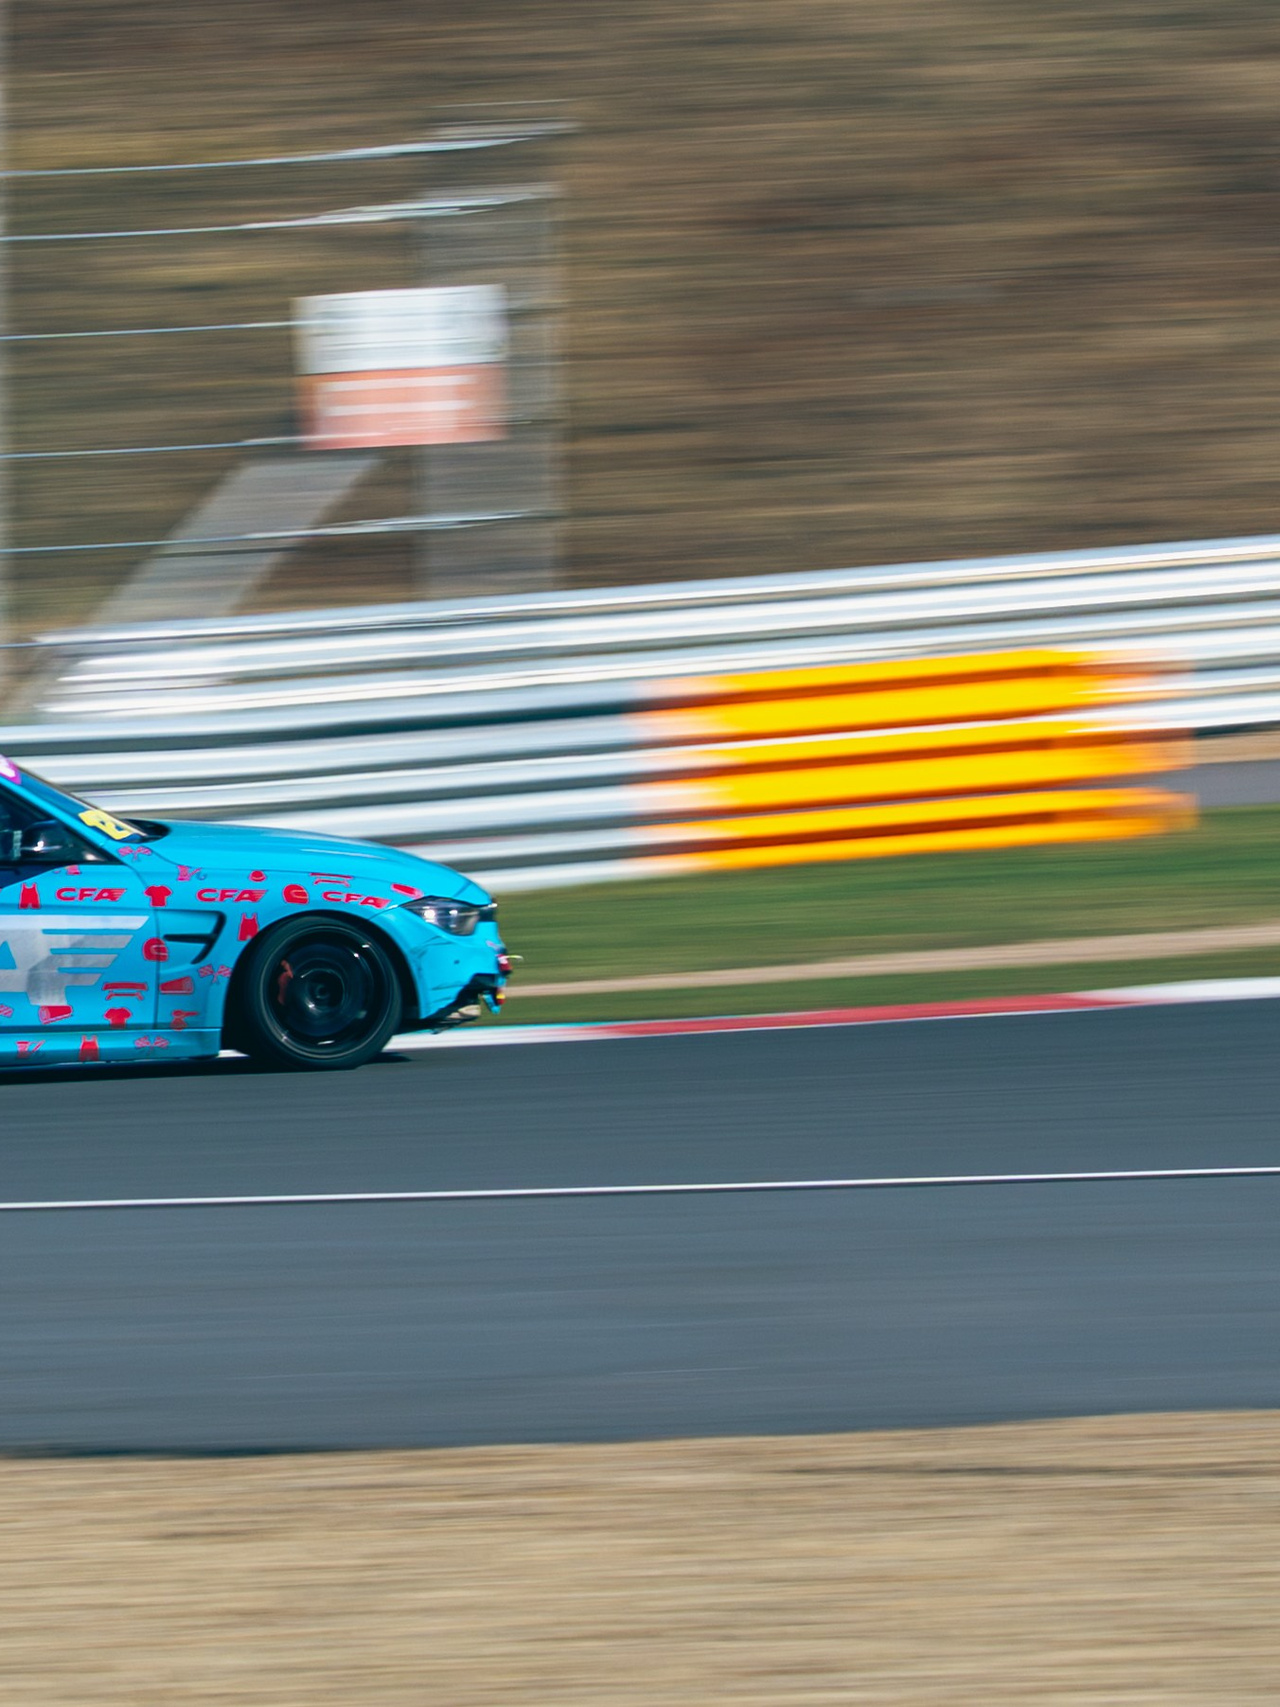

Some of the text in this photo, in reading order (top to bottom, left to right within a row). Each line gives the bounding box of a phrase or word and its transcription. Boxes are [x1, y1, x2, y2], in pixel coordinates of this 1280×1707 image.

[55, 887, 127, 901] CFA
[196, 888, 269, 903] CFA
[322, 891, 393, 909] CFA
